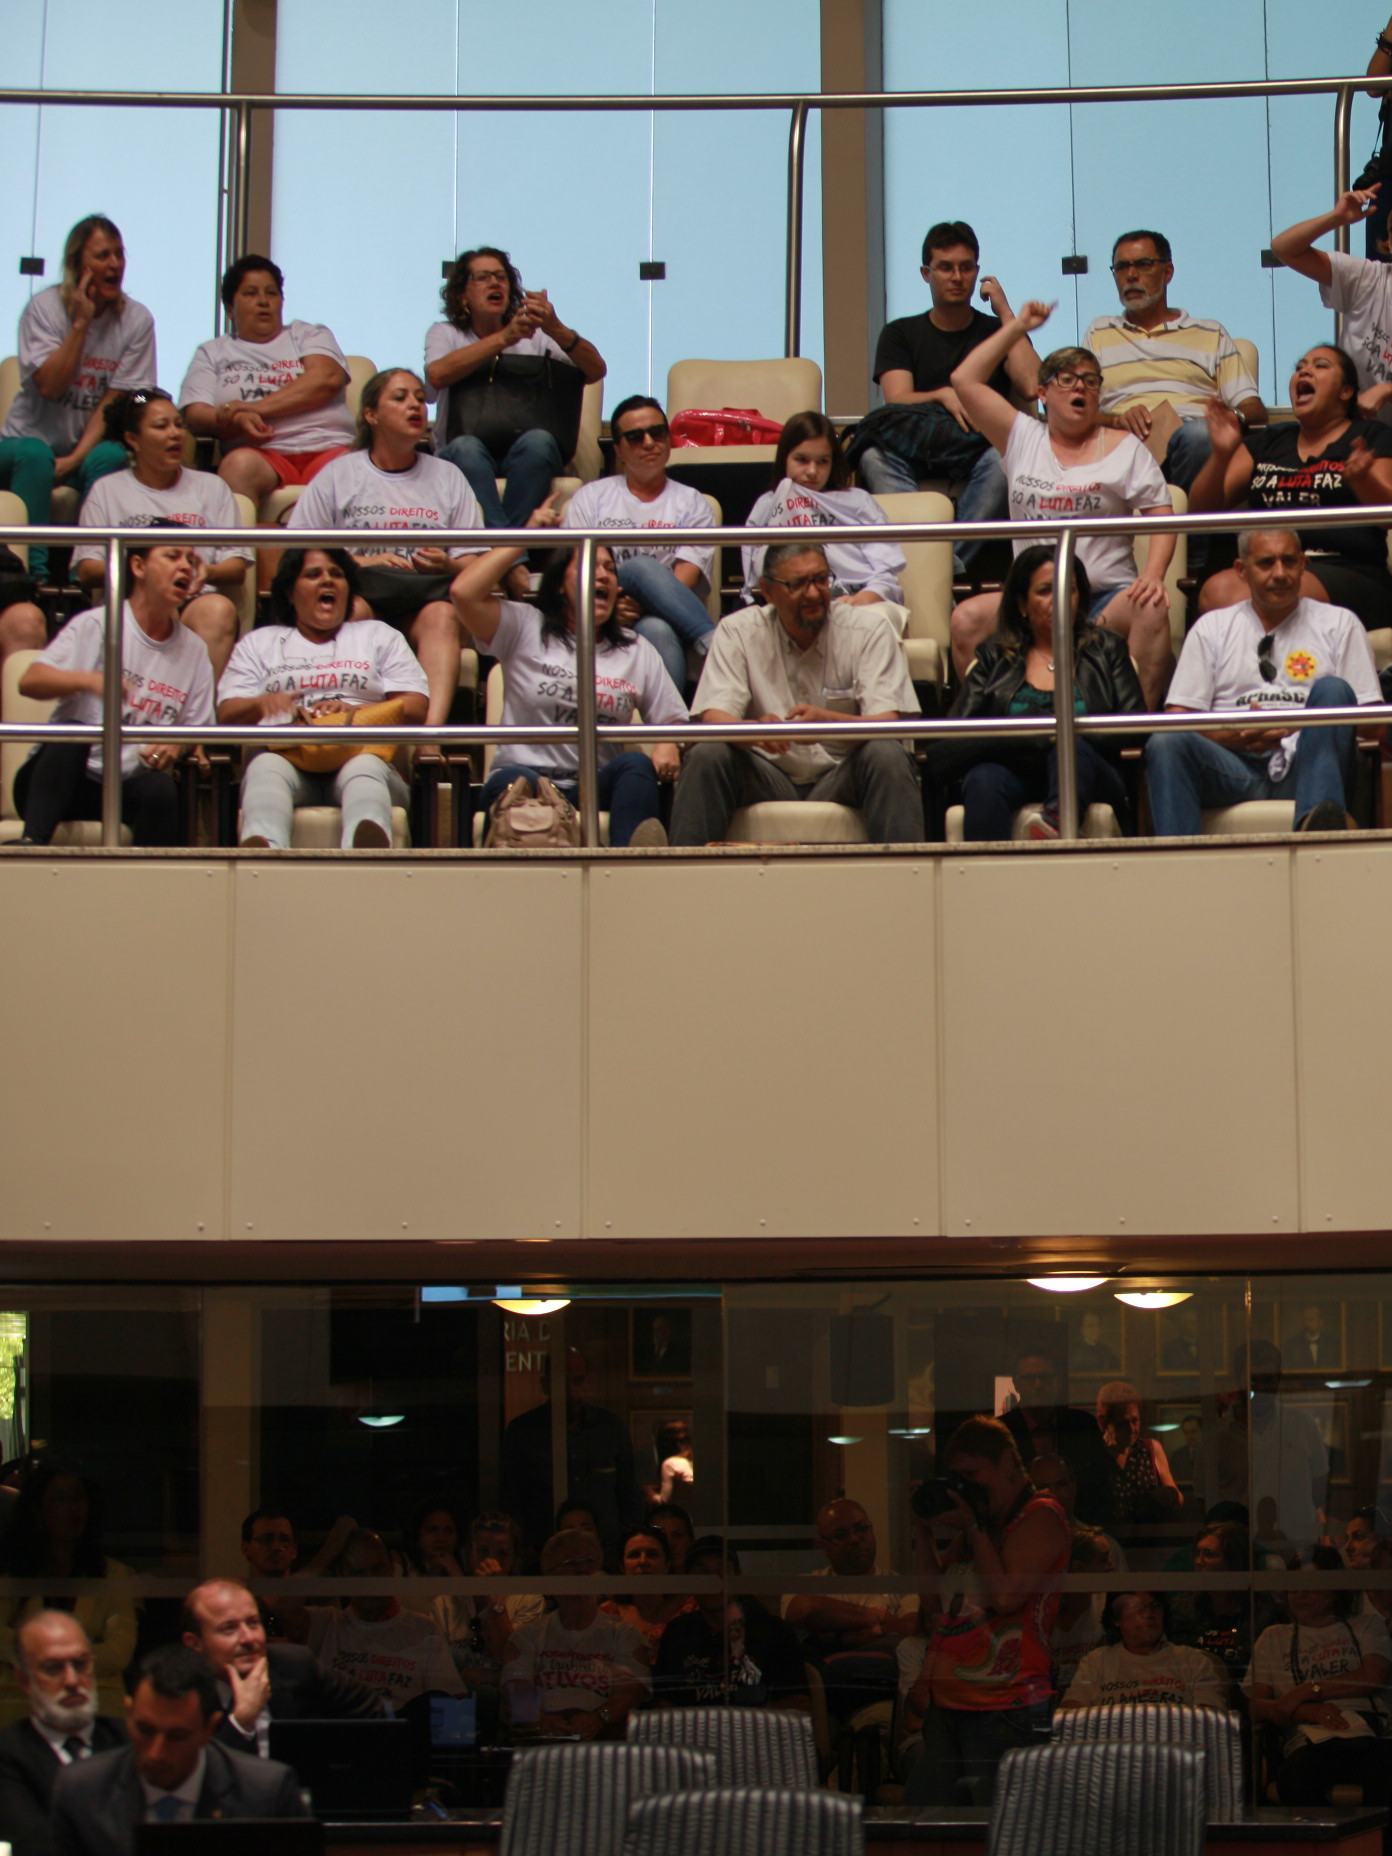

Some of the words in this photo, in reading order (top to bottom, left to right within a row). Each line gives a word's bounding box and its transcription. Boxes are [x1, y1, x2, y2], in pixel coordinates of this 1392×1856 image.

[1277, 474, 1313, 489] LUTA
[1313, 473, 1343, 490] FAZ
[1039, 496, 1074, 511] LUTA
[1075, 496, 1102, 512] FAZ
[389, 507, 441, 521] DIREITOS
[300, 673, 339, 689] LUTA
[340, 673, 369, 691] FAZ
[388, 1672, 412, 1689] FAZ
